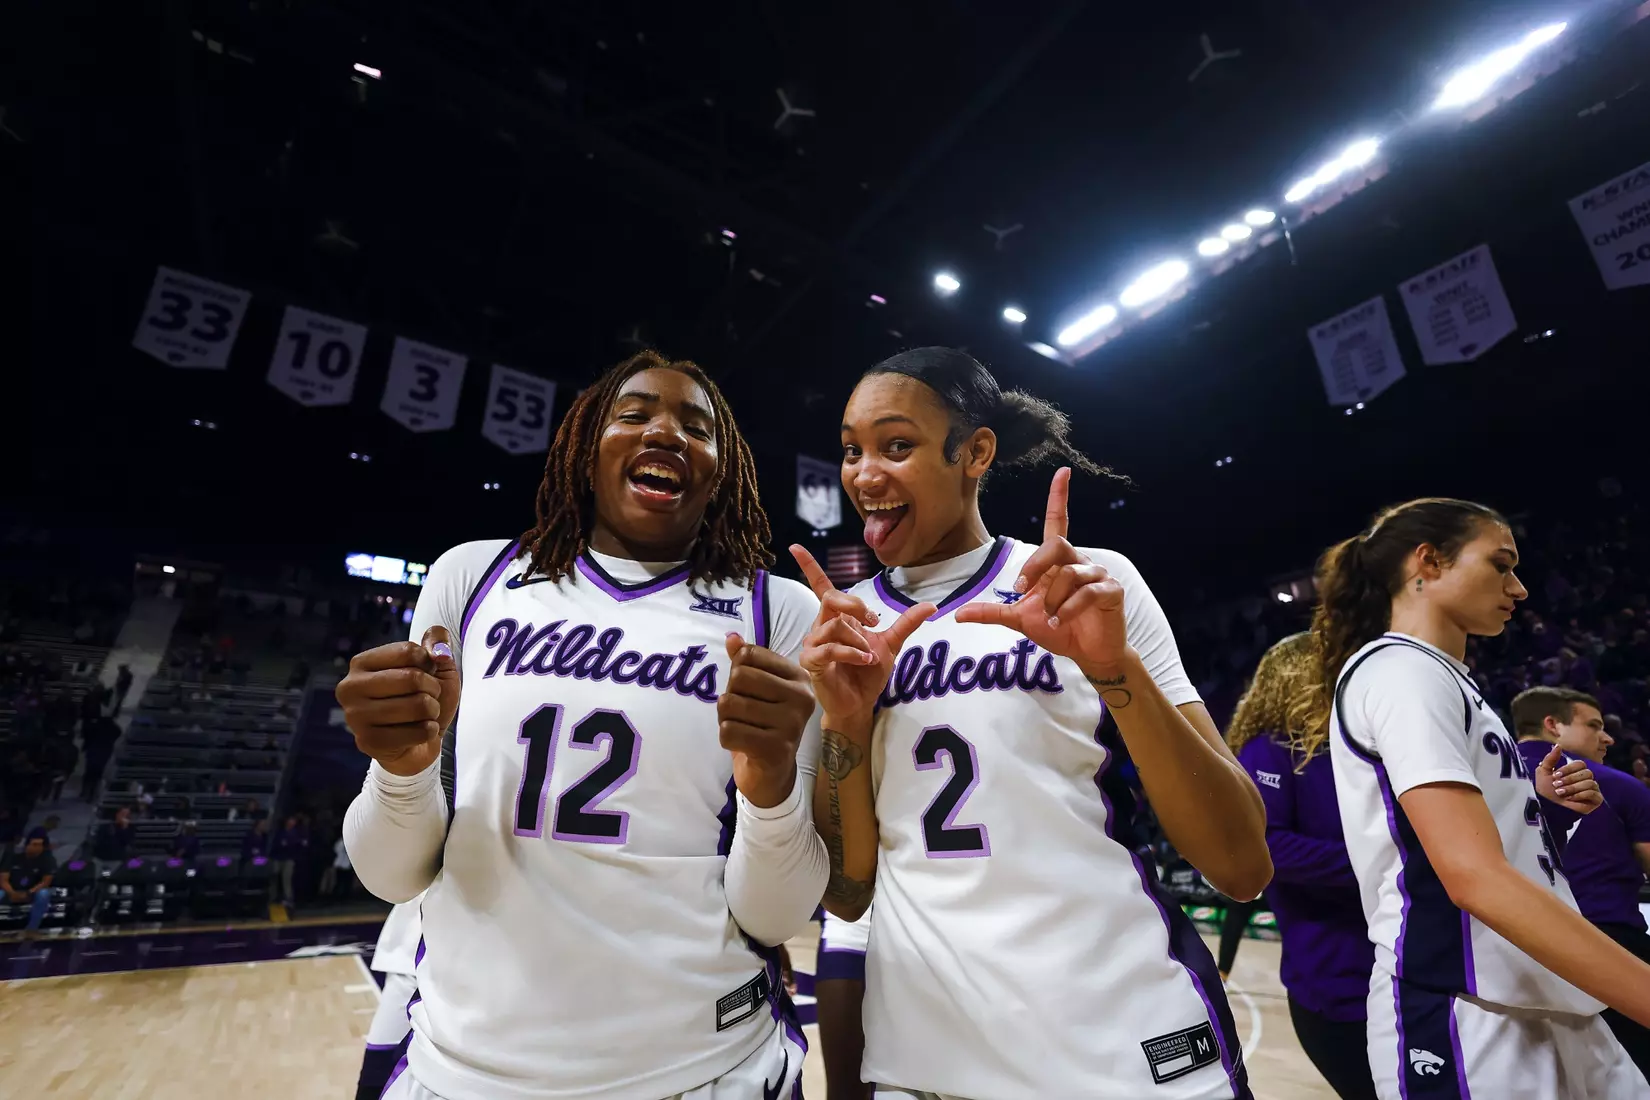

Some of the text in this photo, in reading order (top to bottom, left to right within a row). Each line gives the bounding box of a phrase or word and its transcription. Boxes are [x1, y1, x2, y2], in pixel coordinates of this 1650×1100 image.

[148, 291, 233, 343] 33
[288, 331, 352, 379] 10
[408, 363, 440, 402] 3
[491, 386, 546, 430] 53
[689, 594, 744, 621] XII
[482, 617, 719, 704] Wildcats
[513, 703, 643, 845] 12
[912, 723, 991, 859] 2
[757, 986, 764, 999] L
[1148, 1036, 1187, 1053] ENGINEERED
[1196, 1036, 1210, 1055] M
